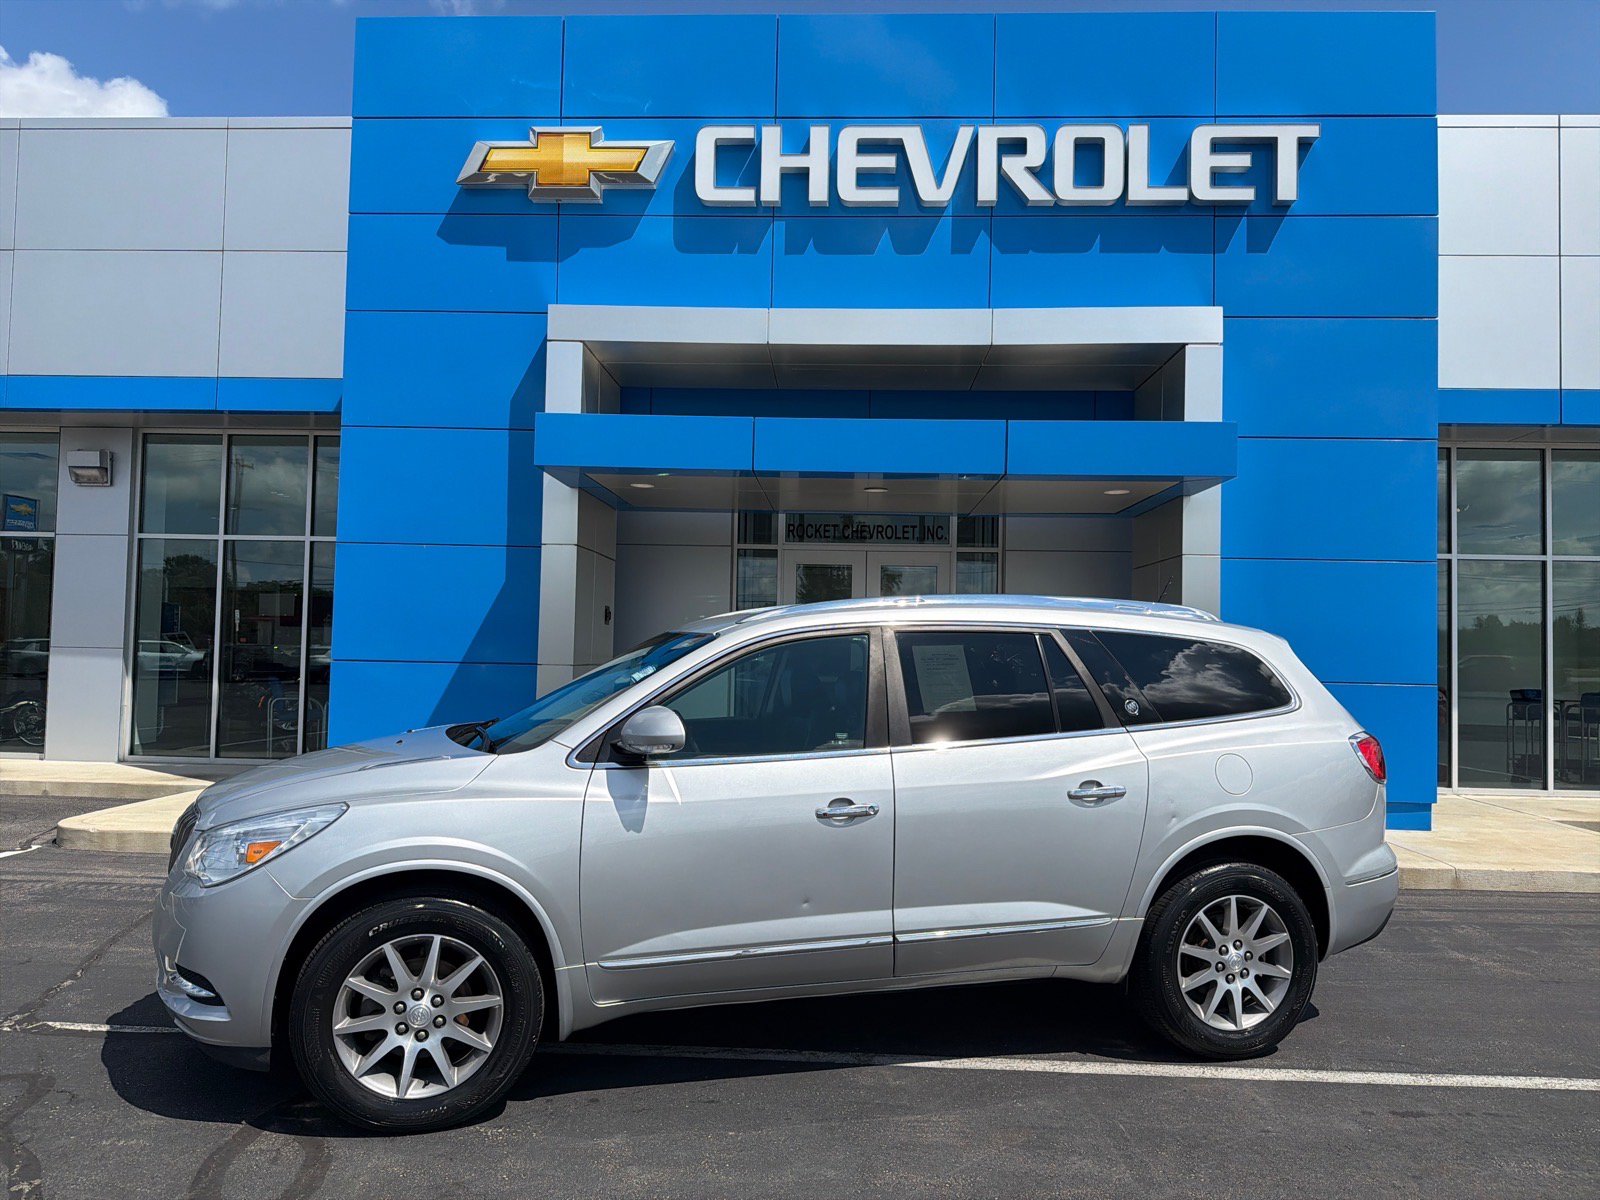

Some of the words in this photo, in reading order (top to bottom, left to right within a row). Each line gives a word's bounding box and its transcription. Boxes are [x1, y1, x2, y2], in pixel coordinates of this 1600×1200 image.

[694, 124, 1321, 208] CHEVROLET
[787, 523, 839, 540] ROCKET
[923, 525, 948, 542] INC.
